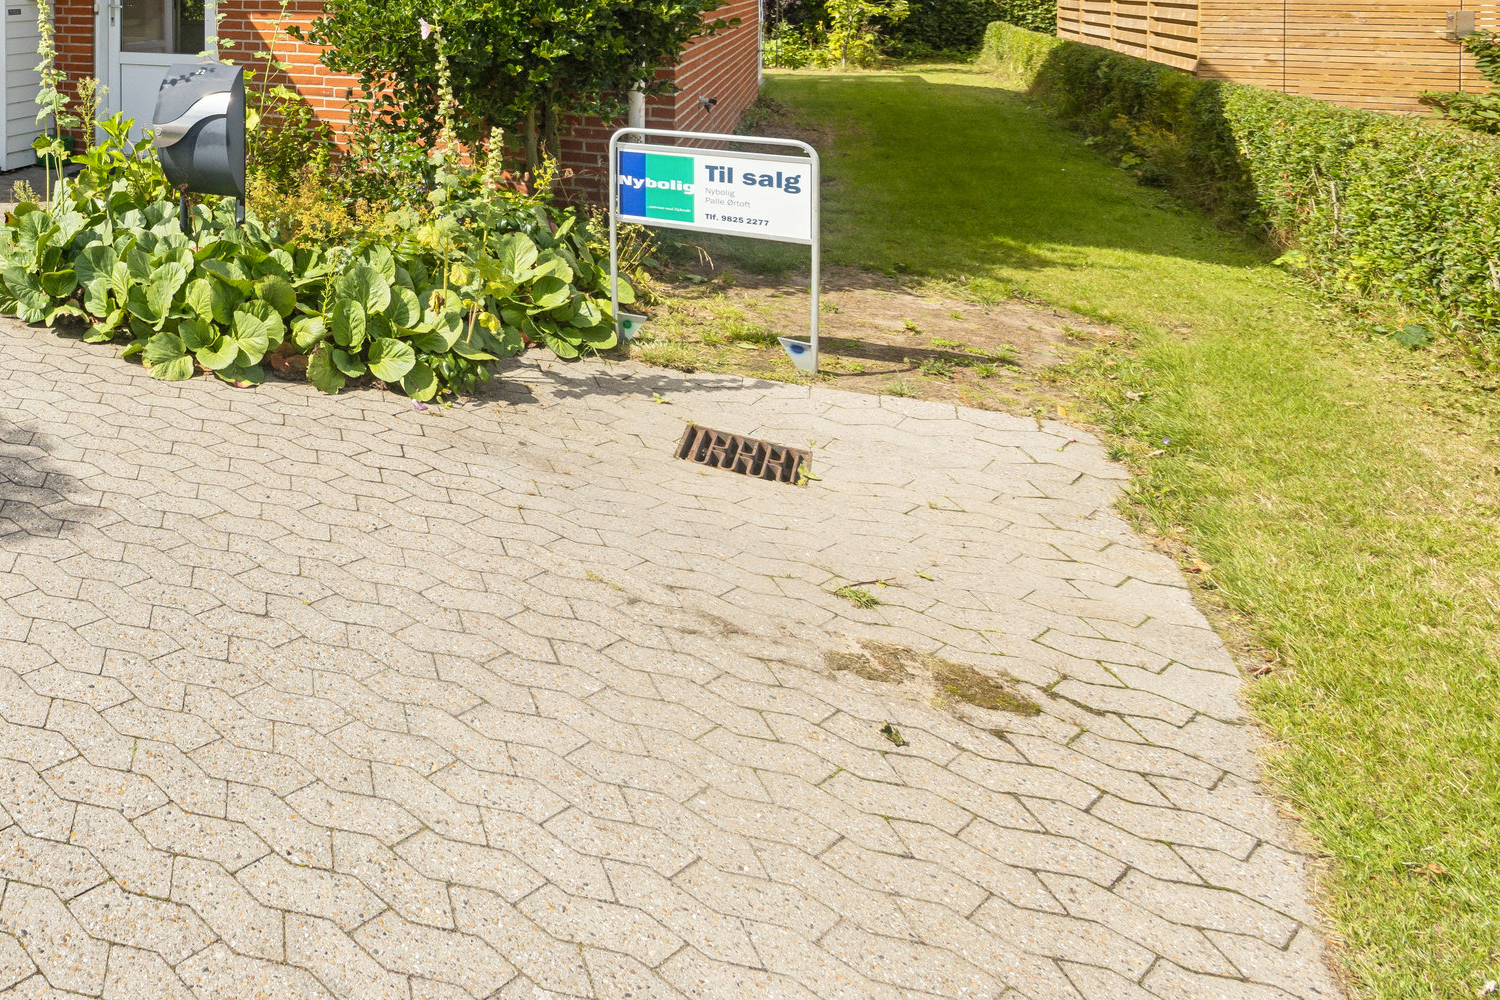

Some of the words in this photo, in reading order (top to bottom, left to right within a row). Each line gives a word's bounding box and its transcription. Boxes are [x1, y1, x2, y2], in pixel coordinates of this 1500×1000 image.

[619, 174, 695, 195] Nybolig
[705, 165, 733, 184] Til
[742, 171, 801, 194] salg
[705, 187, 735, 198] Nybolig
[705, 197, 725, 206] Palle
[727, 199, 751, 208] Ørtoft
[705, 213, 719, 221] Tlf.
[721, 215, 744, 224] 9825
[746, 218, 769, 226] 2277
